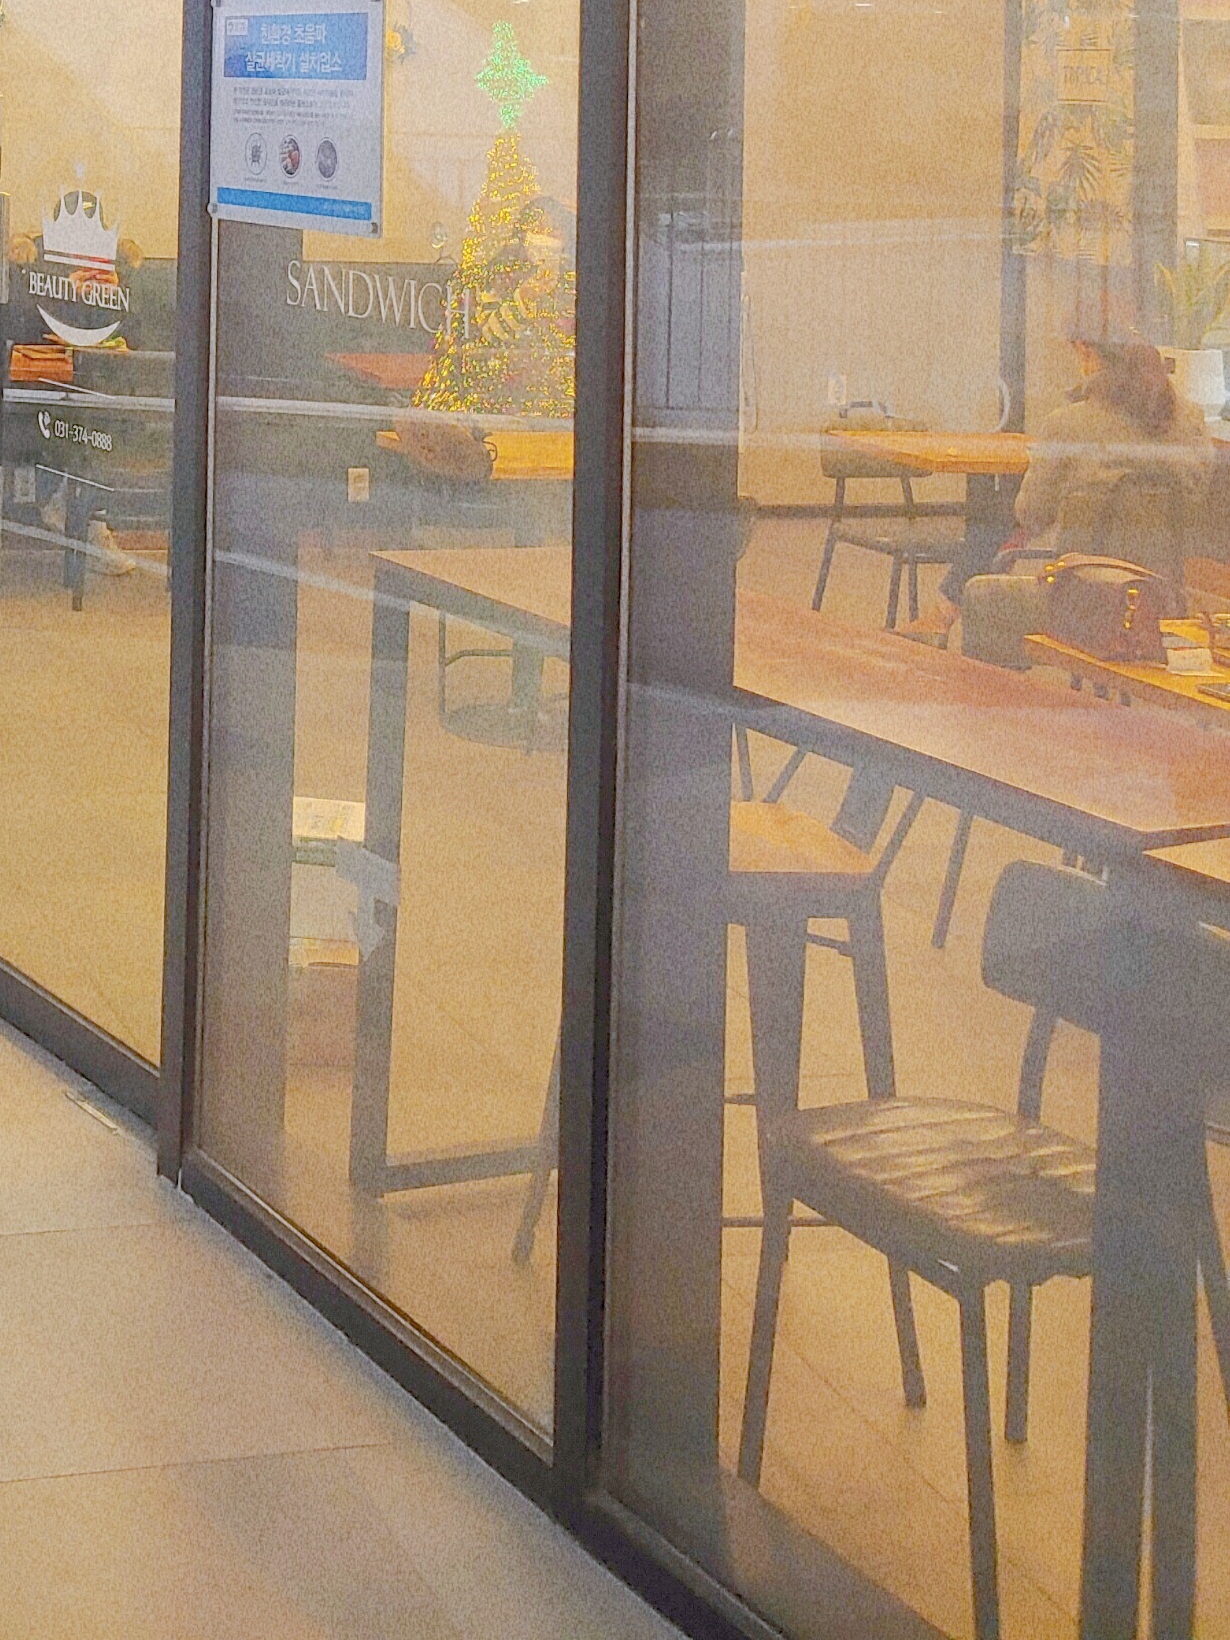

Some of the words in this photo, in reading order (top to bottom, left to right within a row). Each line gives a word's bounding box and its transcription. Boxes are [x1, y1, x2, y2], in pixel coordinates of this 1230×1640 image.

[260, 24, 291, 45] 친환경
[293, 24, 327, 45] 초음파
[29, 271, 77, 302] BEAUTY
[81, 280, 130, 312] GREEN
[286, 260, 470, 340] SANDWICH
[54, 420, 113, 452] 031-374-0888
